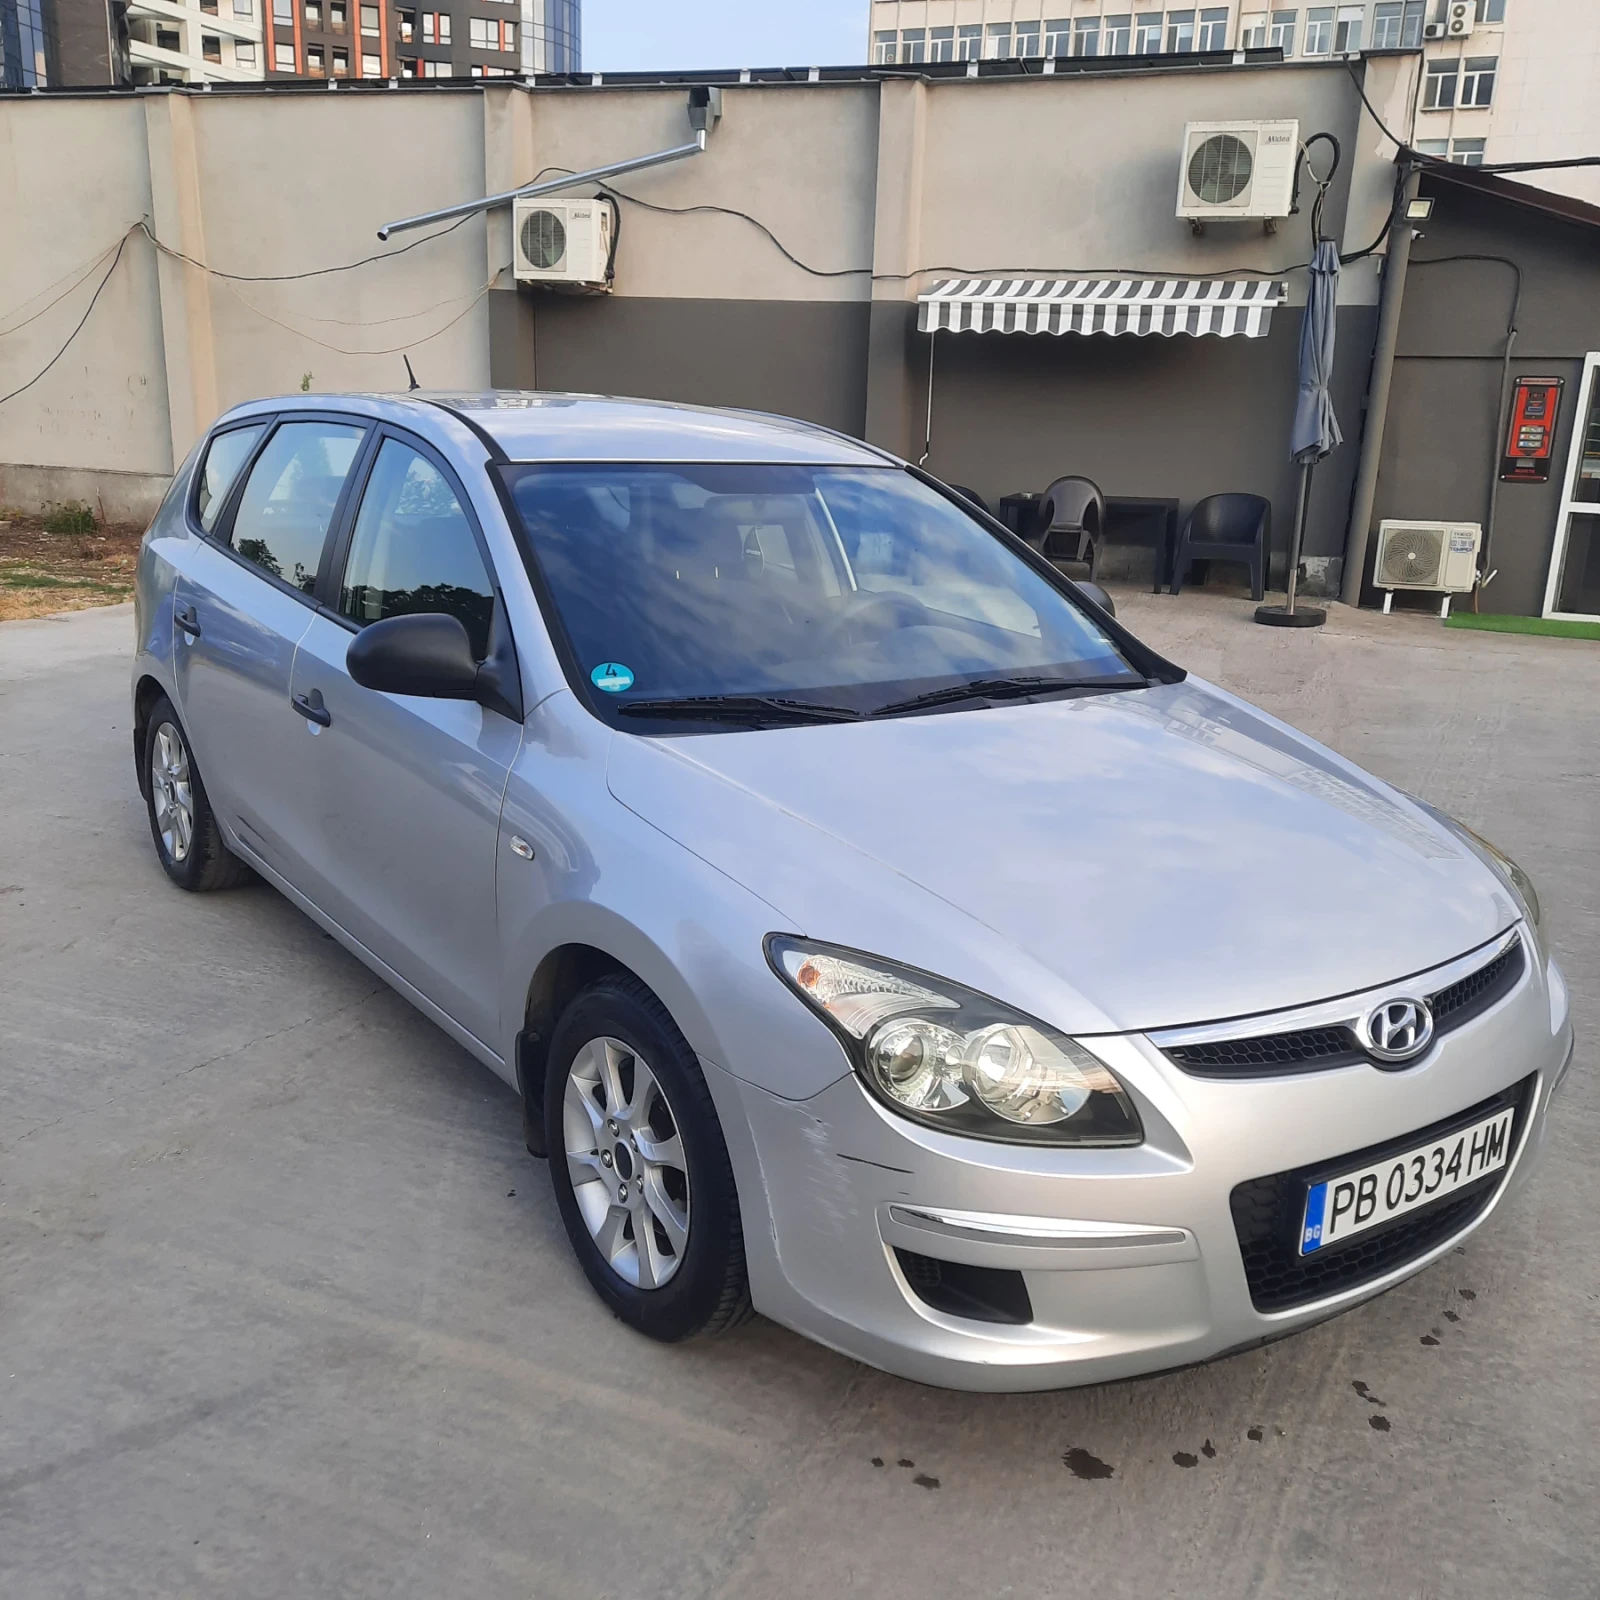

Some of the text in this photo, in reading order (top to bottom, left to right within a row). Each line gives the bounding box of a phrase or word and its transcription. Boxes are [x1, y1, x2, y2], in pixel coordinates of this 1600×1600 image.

[1265, 135, 1290, 144] Midea
[605, 663, 618, 677] 4
[1330, 1117, 1508, 1234] PB 0334 HM
[1304, 1225, 1321, 1243] BG
